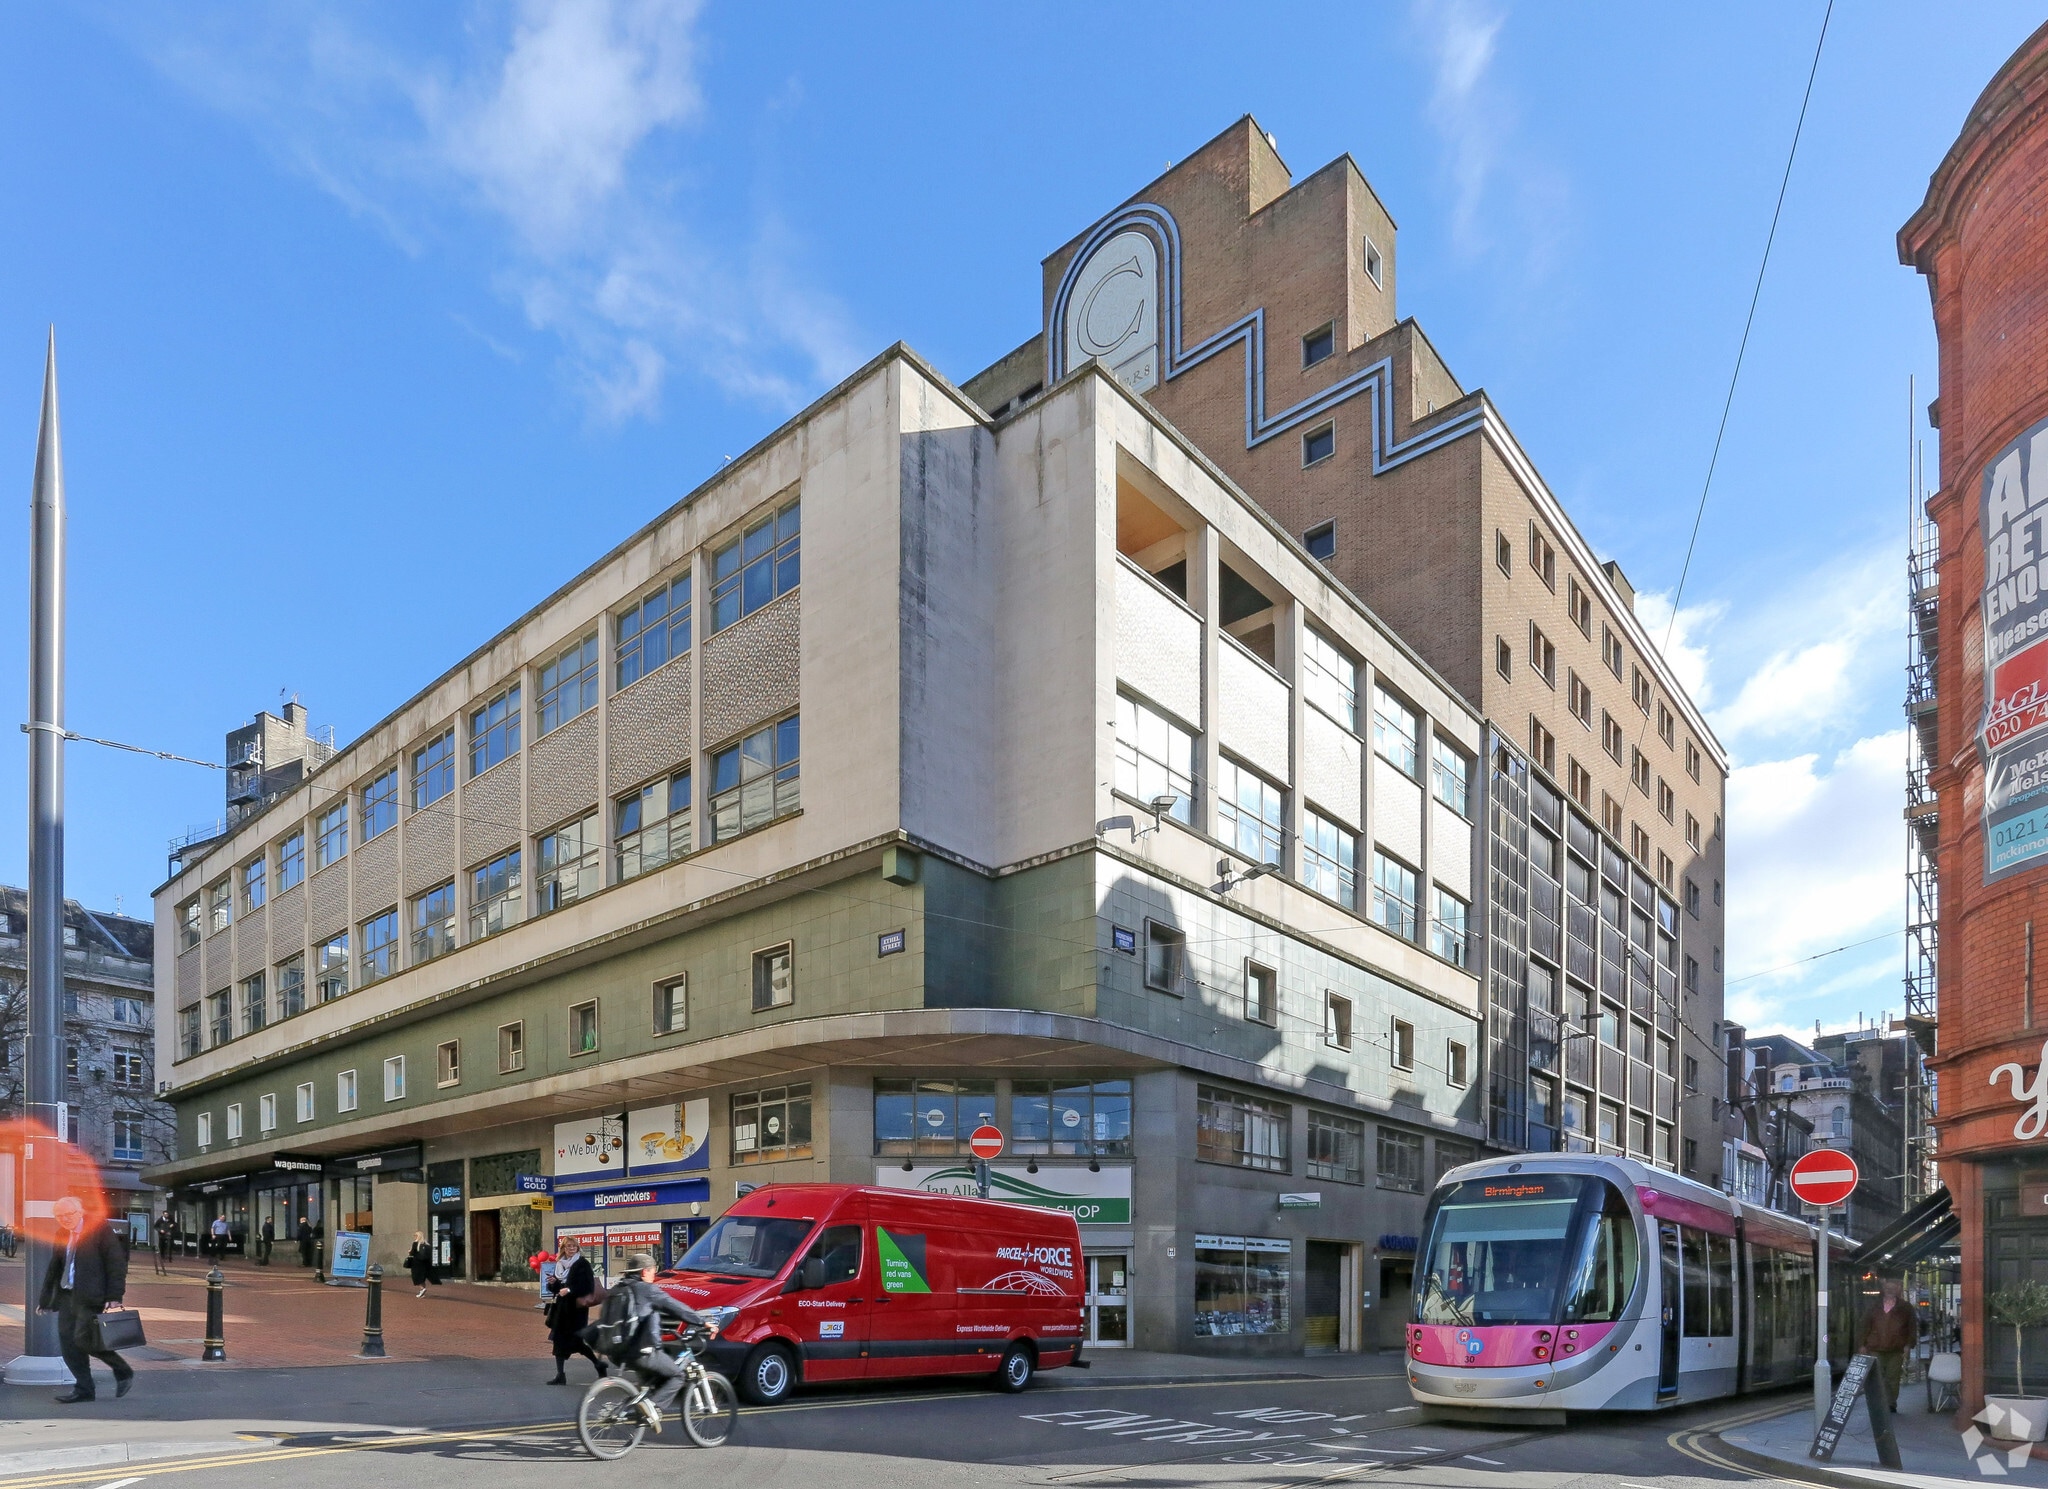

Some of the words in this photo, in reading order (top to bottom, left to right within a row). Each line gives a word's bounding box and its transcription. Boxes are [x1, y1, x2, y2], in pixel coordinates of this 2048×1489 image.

[1077, 255, 1144, 357] C
[1990, 608, 2048, 661] Please
[1990, 715, 2020, 743] 020
[1996, 818, 2038, 847] 0121
[568, 1144, 584, 1156] We
[586, 1140, 600, 1157] buy
[275, 1160, 322, 1171] wagamama
[524, 1182, 547, 1190] GOLD
[1484, 1185, 1545, 1198] Birmingham
[581, 1236, 593, 1244] SALE
[593, 1235, 605, 1243] SALE
[609, 1236, 620, 1244] SALE
[621, 1235, 633, 1243] SALE
[635, 1234, 646, 1242] SALE
[647, 1233, 660, 1241] SALE
[996, 1247, 1022, 1261] PARCEL
[1033, 1247, 1073, 1267] FORCE
[886, 1259, 909, 1271] Turning
[886, 1269, 896, 1280] red
[898, 1271, 912, 1279] vans
[1040, 1265, 1074, 1280] WORLDWIDE
[886, 1280, 904, 1291] green
[798, 1300, 825, 1308] ECO-Start
[826, 1300, 847, 1309] Delivery
[956, 1324, 973, 1333] Express
[995, 1325, 1011, 1333] Delivery
[1464, 1355, 1475, 1364] 30
[1212, 1407, 1337, 1424] NO
[1019, 1409, 1306, 1445] ENTRY
